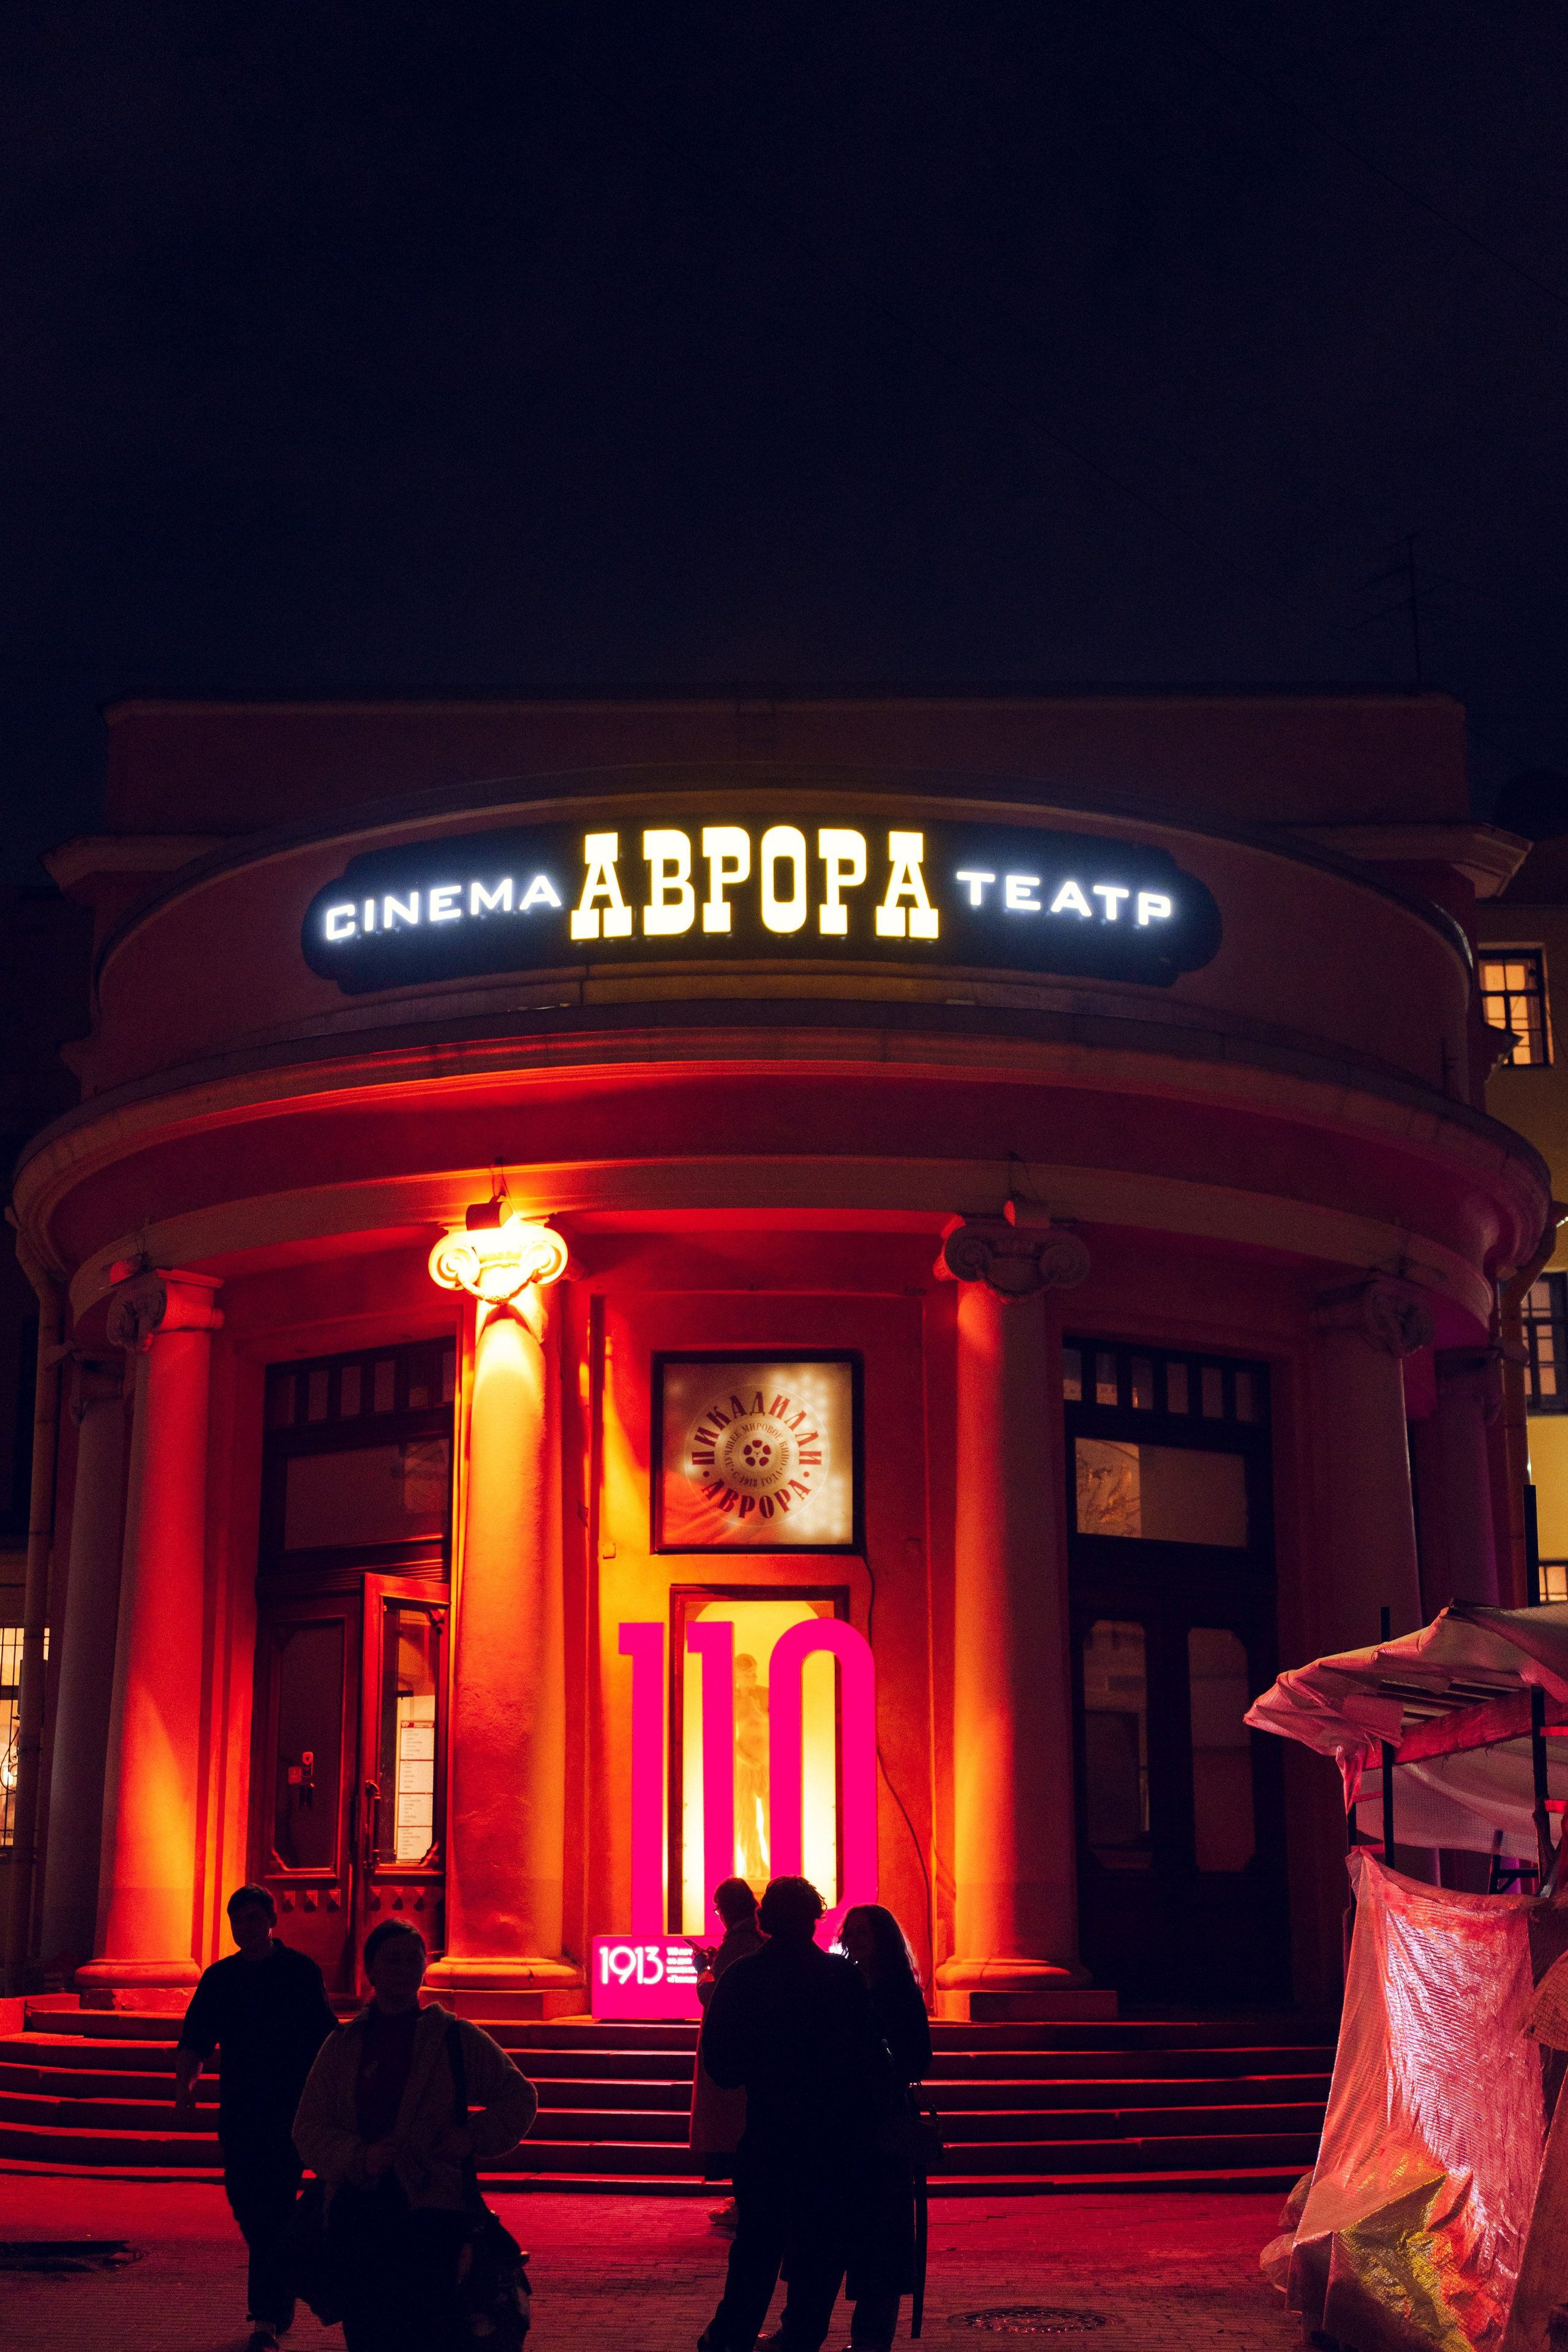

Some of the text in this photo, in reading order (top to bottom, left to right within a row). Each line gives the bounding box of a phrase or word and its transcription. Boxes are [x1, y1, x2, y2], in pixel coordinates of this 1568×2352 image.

[323, 873, 562, 942] CINEMA
[570, 825, 940, 940] АВРОРА
[955, 870, 1173, 928] ТЕАТР
[692, 1391, 822, 1466] ПИКАДИЛЛИ
[701, 1479, 812, 1519] АВРОРА
[618, 1617, 879, 1936] 110
[599, 1947, 664, 1985] 1913
